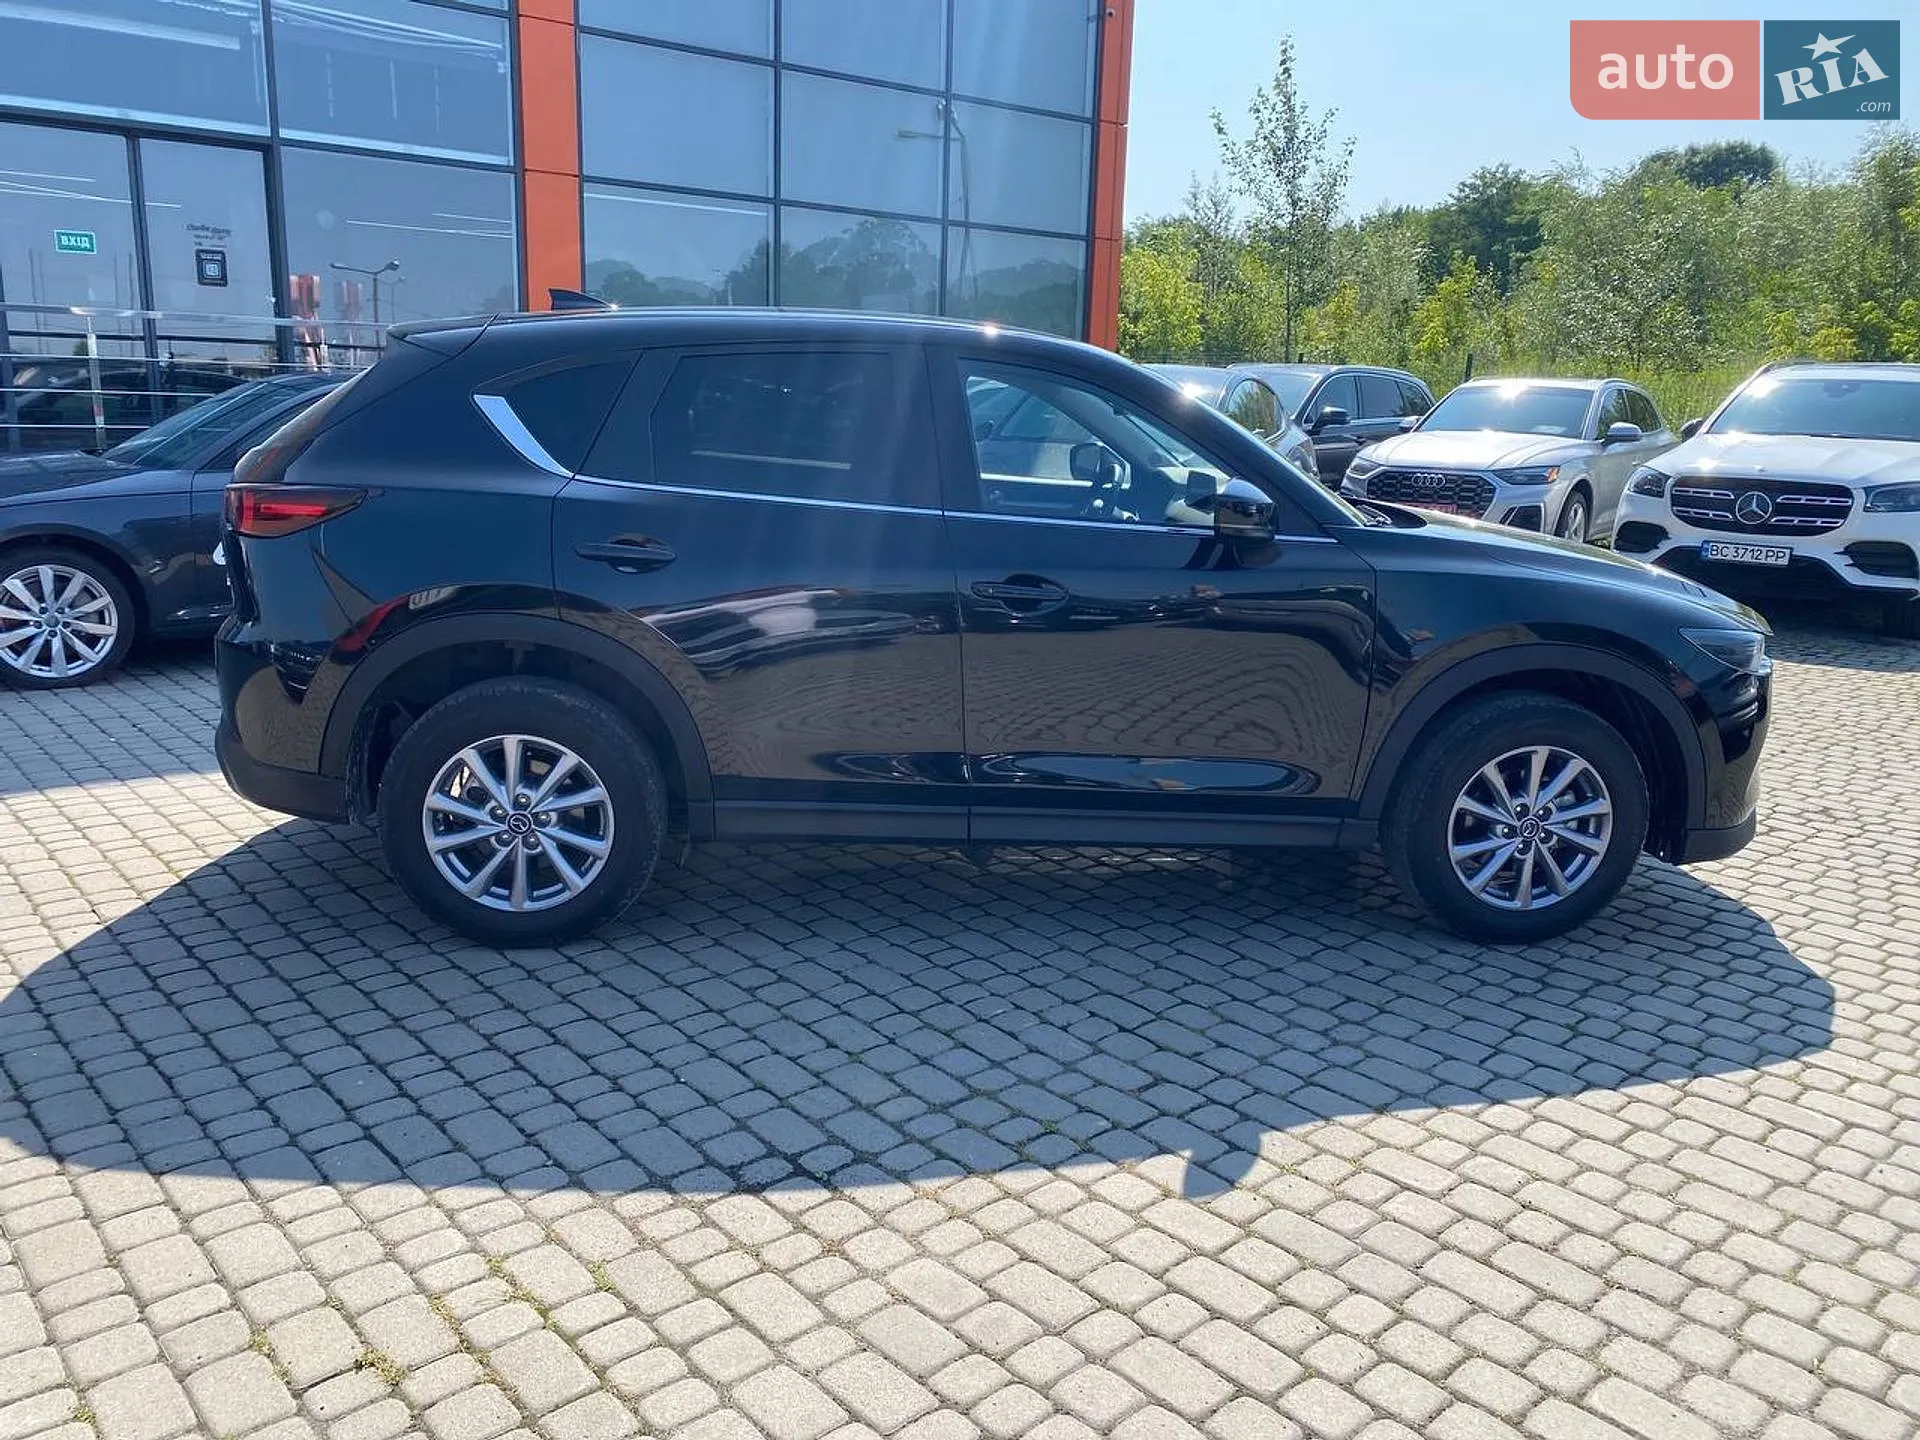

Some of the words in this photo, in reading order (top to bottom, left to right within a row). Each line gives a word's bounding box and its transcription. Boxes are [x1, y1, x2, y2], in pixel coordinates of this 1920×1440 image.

[60, 235, 90, 249] ВХІД
[1709, 544, 1729, 557] BC
[1732, 546, 1763, 561] 3712
[1765, 549, 1786, 562] PP
